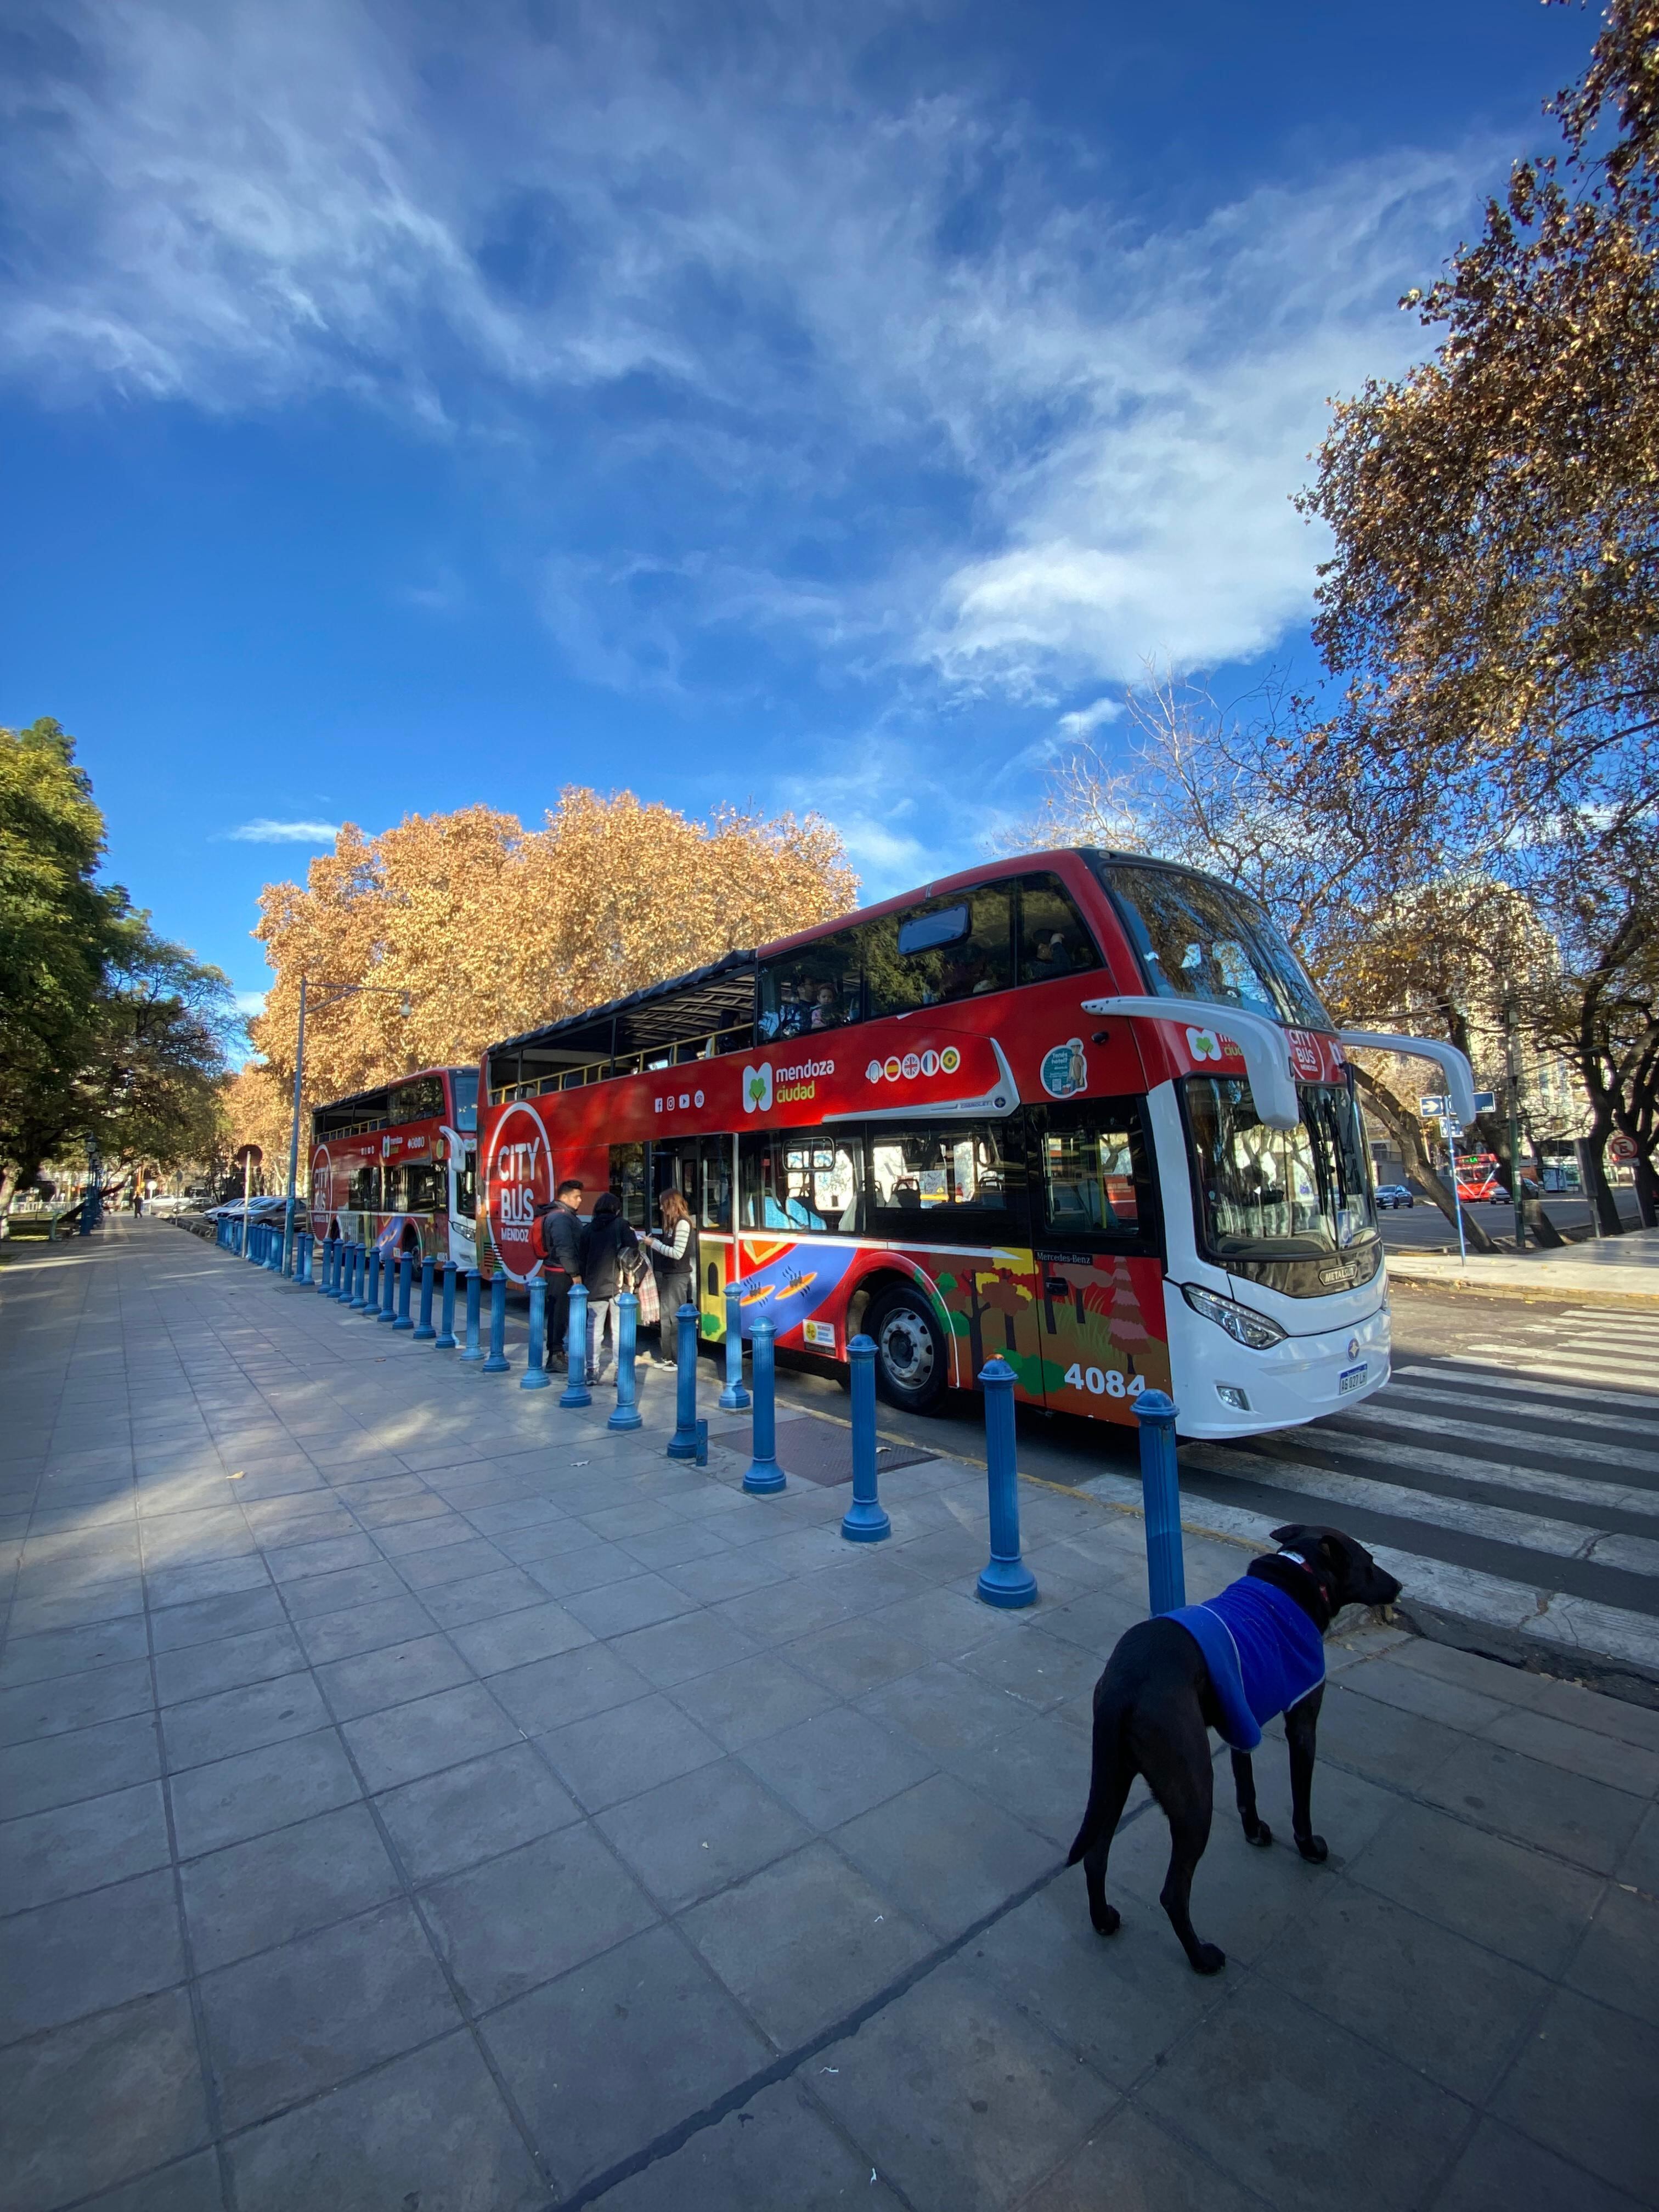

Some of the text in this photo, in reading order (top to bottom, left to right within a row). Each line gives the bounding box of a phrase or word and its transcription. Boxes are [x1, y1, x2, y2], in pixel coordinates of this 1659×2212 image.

[1289, 1029, 1312, 1048] CITY
[1295, 1046, 1316, 1065] BUS
[776, 1059, 835, 1083] mendoza
[776, 1080, 815, 1104] ciudad
[498, 1136, 540, 1181] CITY
[314, 1164, 329, 1189] CITY
[501, 1183, 534, 1223] BUS
[501, 1227, 529, 1243] MENDOZ
[1036, 1252, 1091, 1264] Mercedes-Benz
[1064, 1363, 1146, 1398] 4084
[1349, 1374, 1359, 1388] 027
